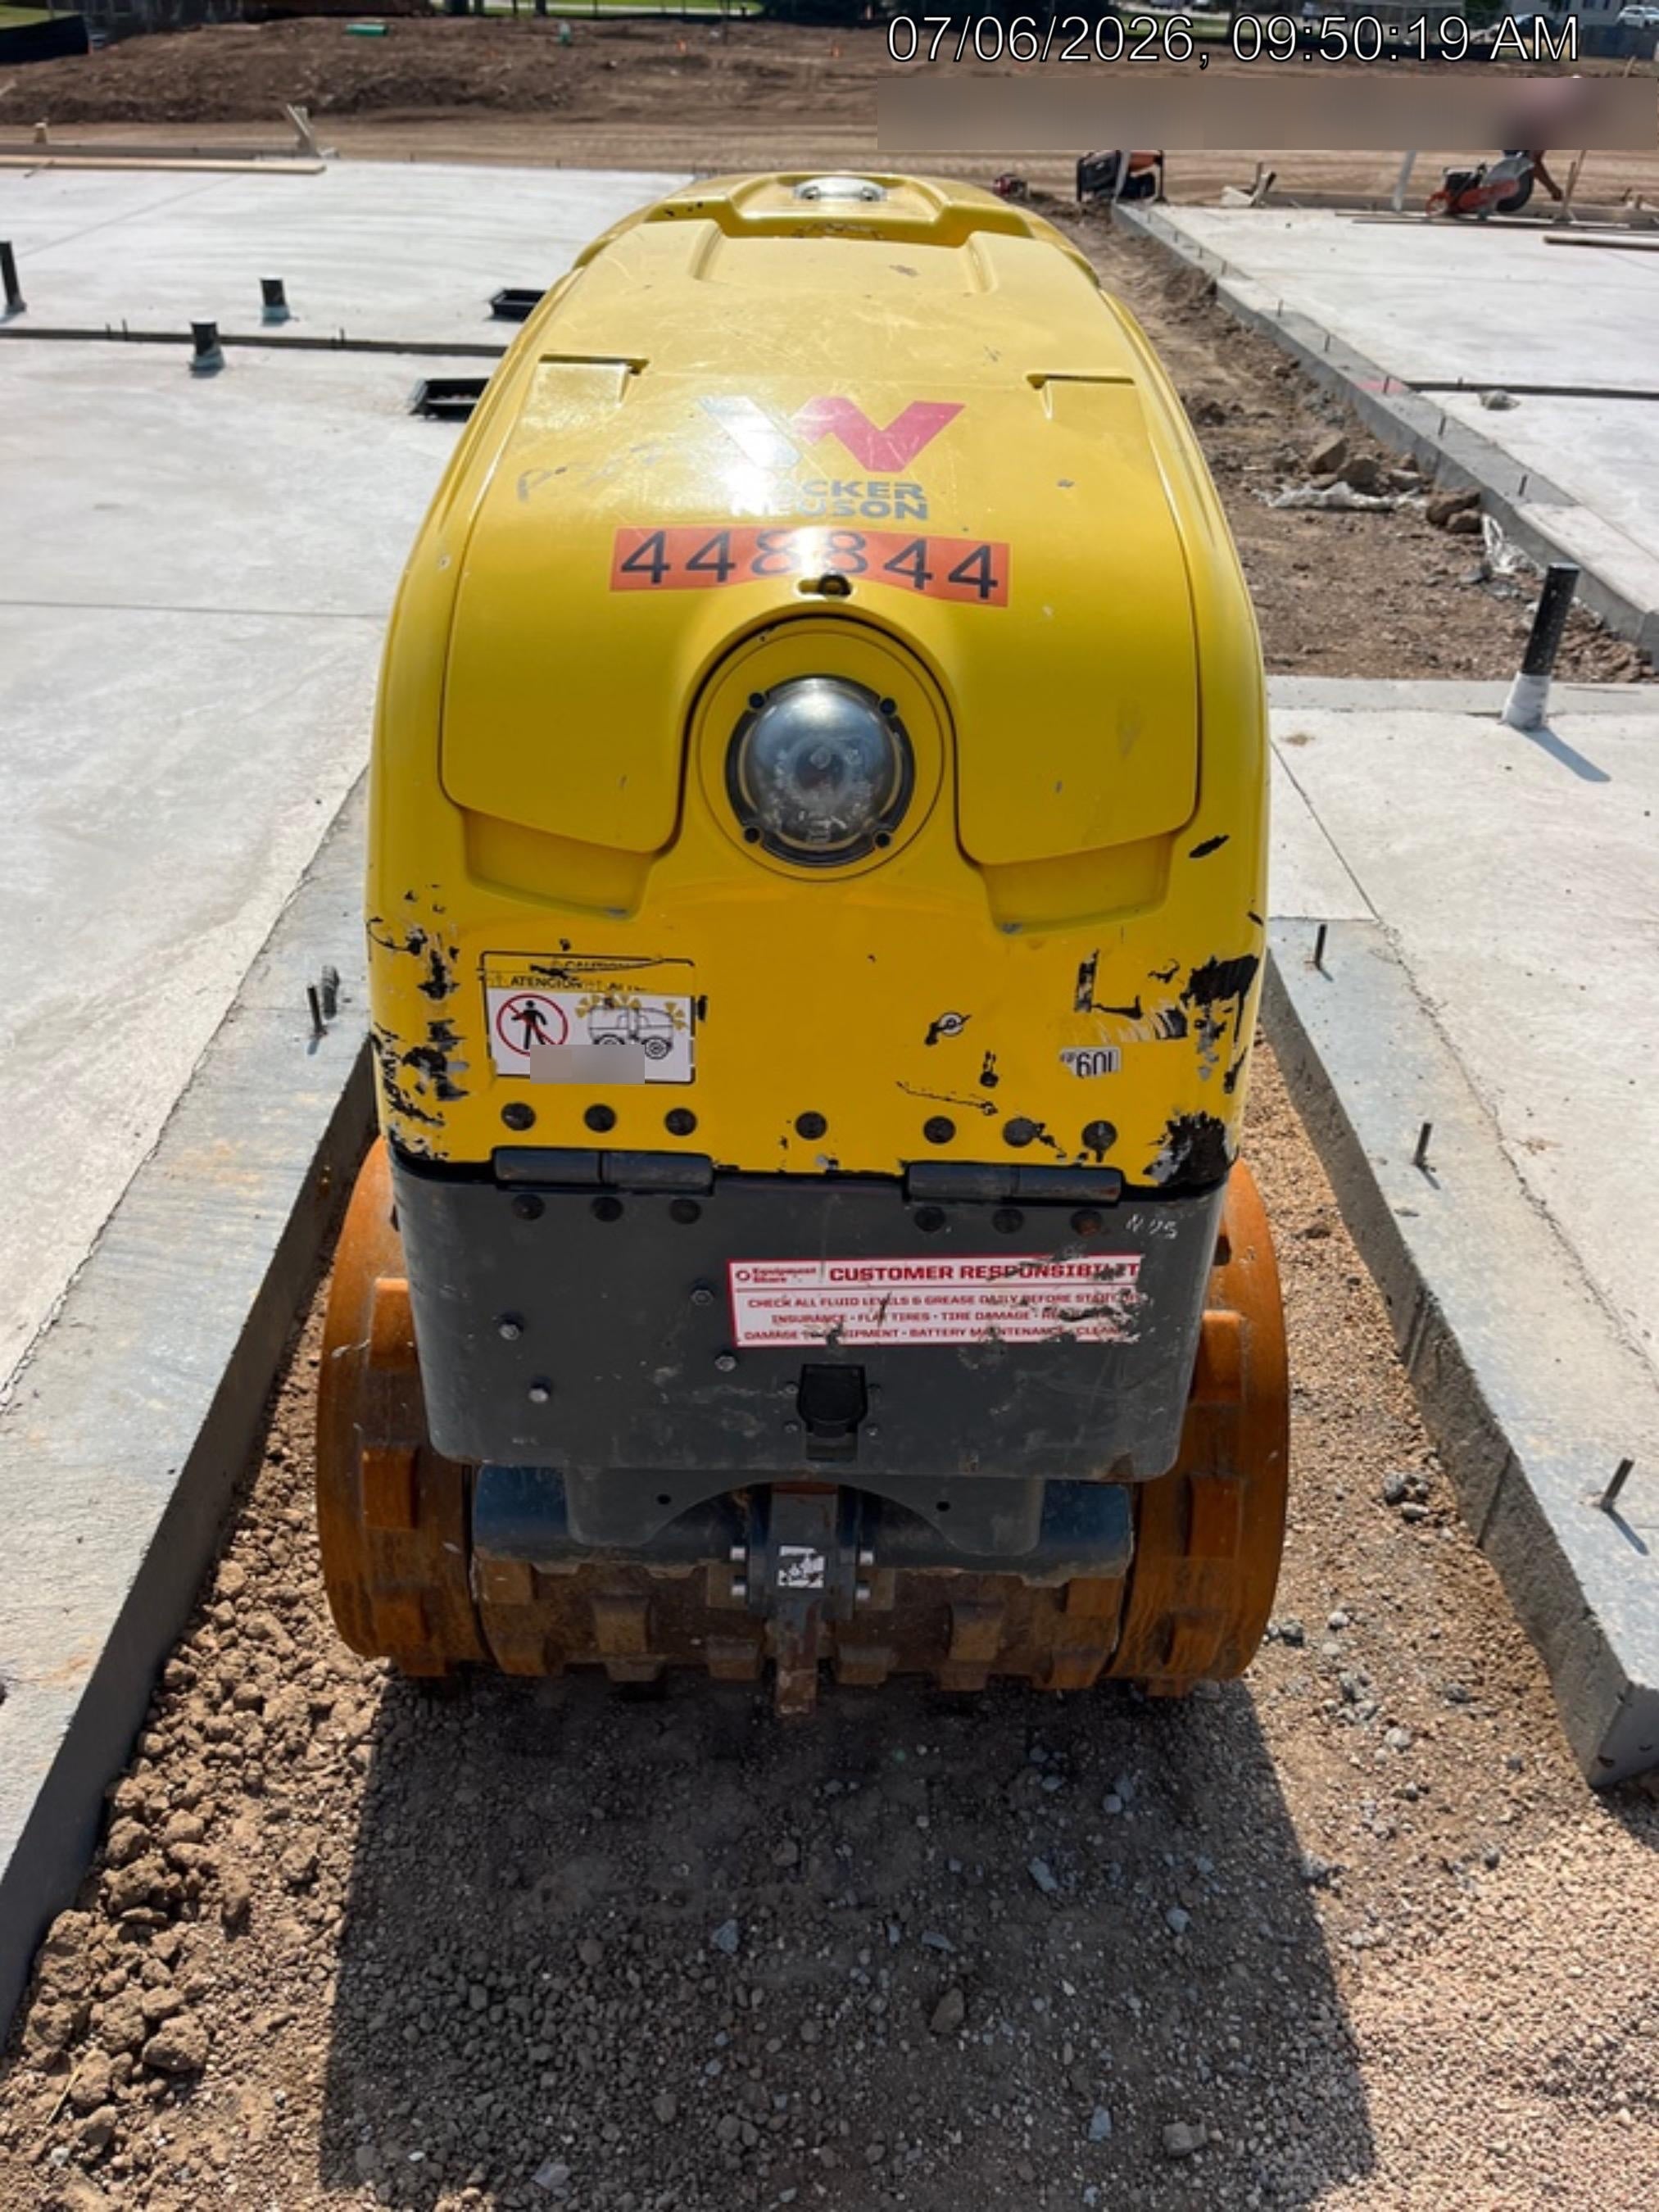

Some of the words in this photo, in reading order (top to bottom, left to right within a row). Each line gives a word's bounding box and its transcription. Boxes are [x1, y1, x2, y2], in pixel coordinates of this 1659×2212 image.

[732, 498, 928, 519] EUSON
[620, 529, 999, 600] 448844
[829, 1265, 954, 1281] CUSTOMER
[960, 1262, 1140, 1280] RESPONSIBIIT
[748, 1298, 791, 1308] CHECK
[795, 1298, 818, 1308] ALL
[821, 1297, 859, 1307] FLUID
[924, 1295, 975, 1305] GREASE
[825, 1328, 898, 1339] UIPMENT
[970, 1326, 1063, 1338] MANTENANCE
